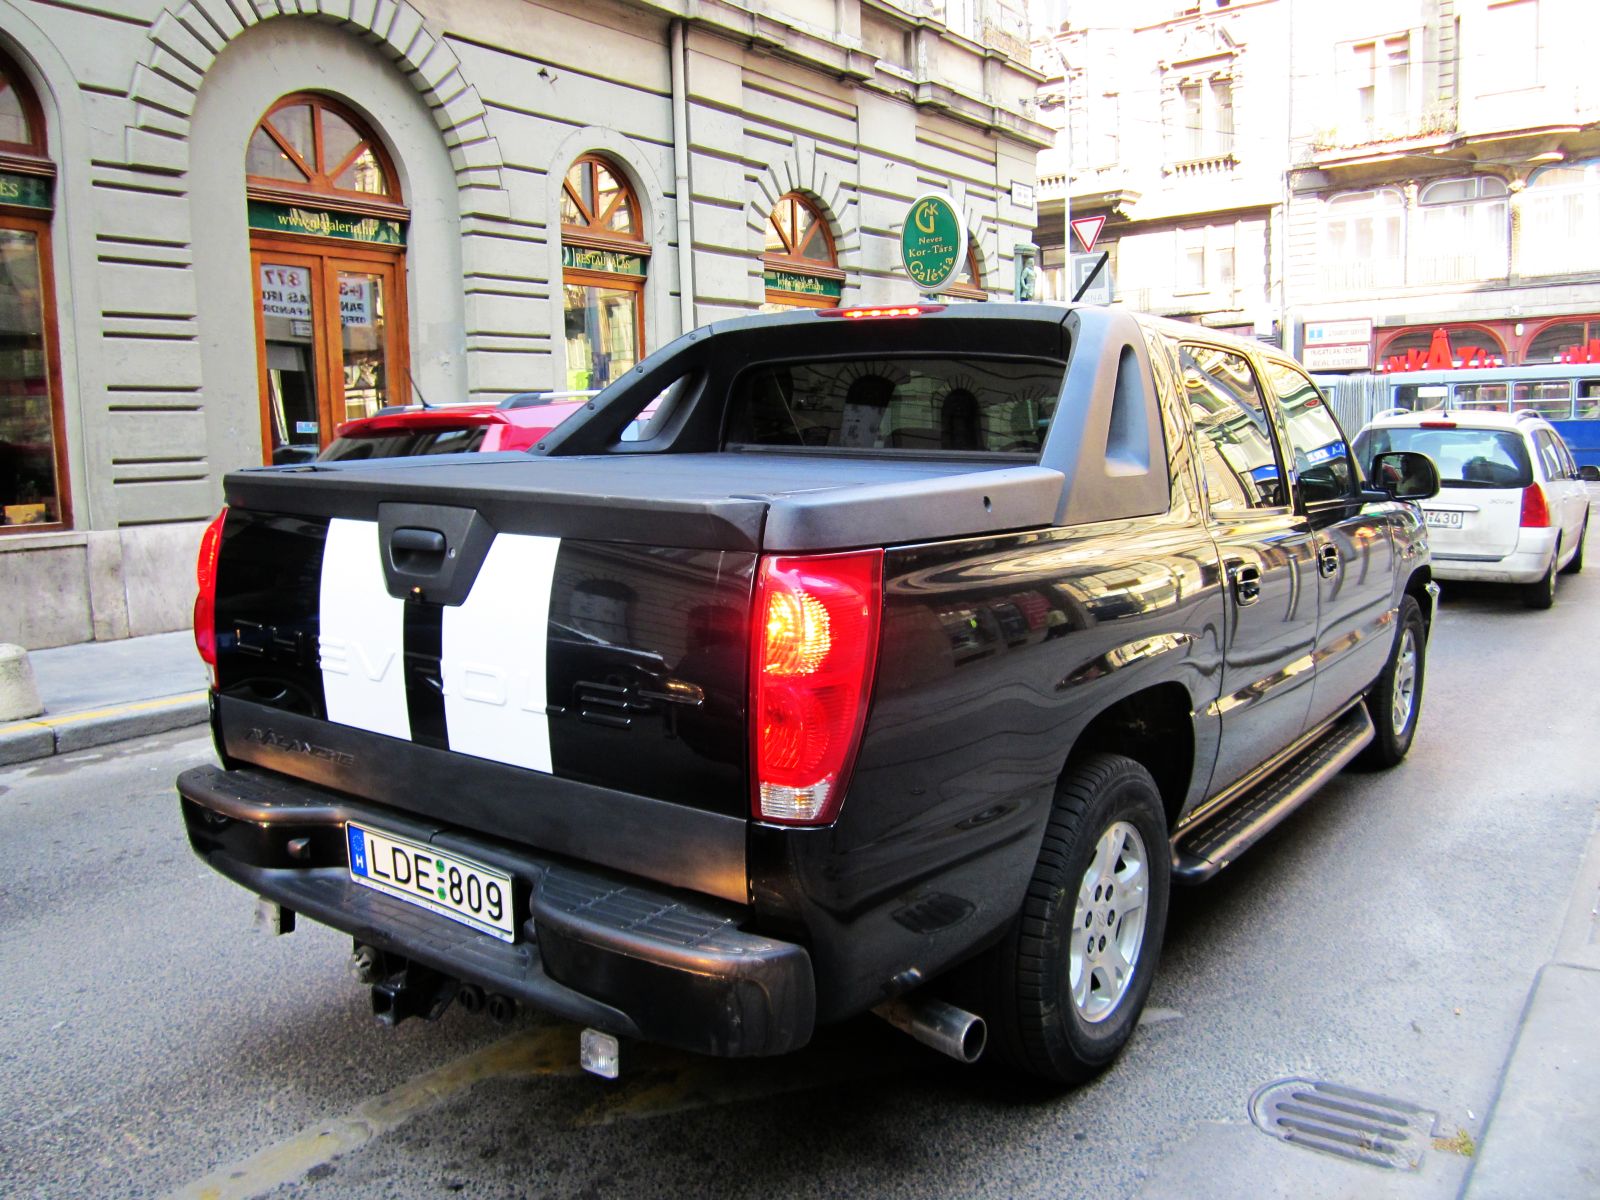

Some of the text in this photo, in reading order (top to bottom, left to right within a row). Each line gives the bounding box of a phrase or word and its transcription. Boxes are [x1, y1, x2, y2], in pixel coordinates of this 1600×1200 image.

[918, 236, 943, 245] Neves
[909, 256, 954, 282] Galéria
[233, 618, 704, 738] CHEVROLET
[245, 728, 355, 767] AVALANCHE
[355, 854, 364, 869] H
